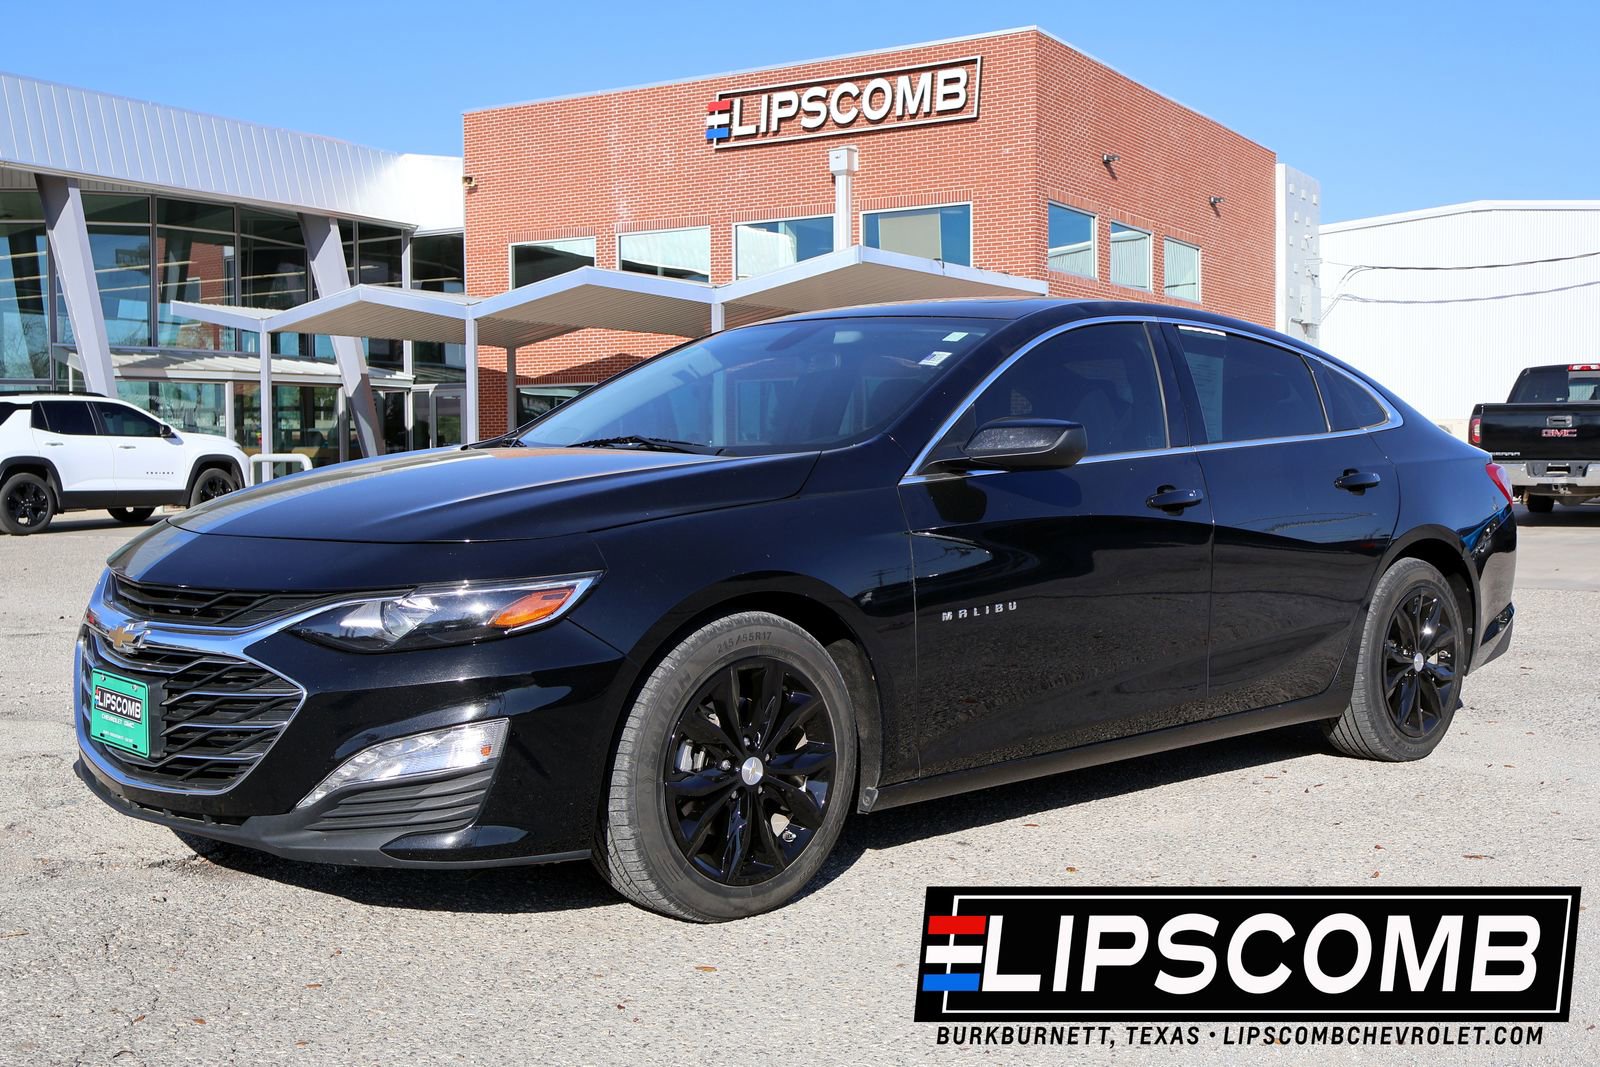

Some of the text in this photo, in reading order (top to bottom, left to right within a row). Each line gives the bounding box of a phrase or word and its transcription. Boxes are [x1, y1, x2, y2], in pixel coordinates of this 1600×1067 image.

[730, 66, 968, 137] LIPSCOMB
[1541, 429, 1578, 438] GMC
[942, 601, 1017, 622] MALIBU
[98, 690, 141, 719] LIPSCOMB
